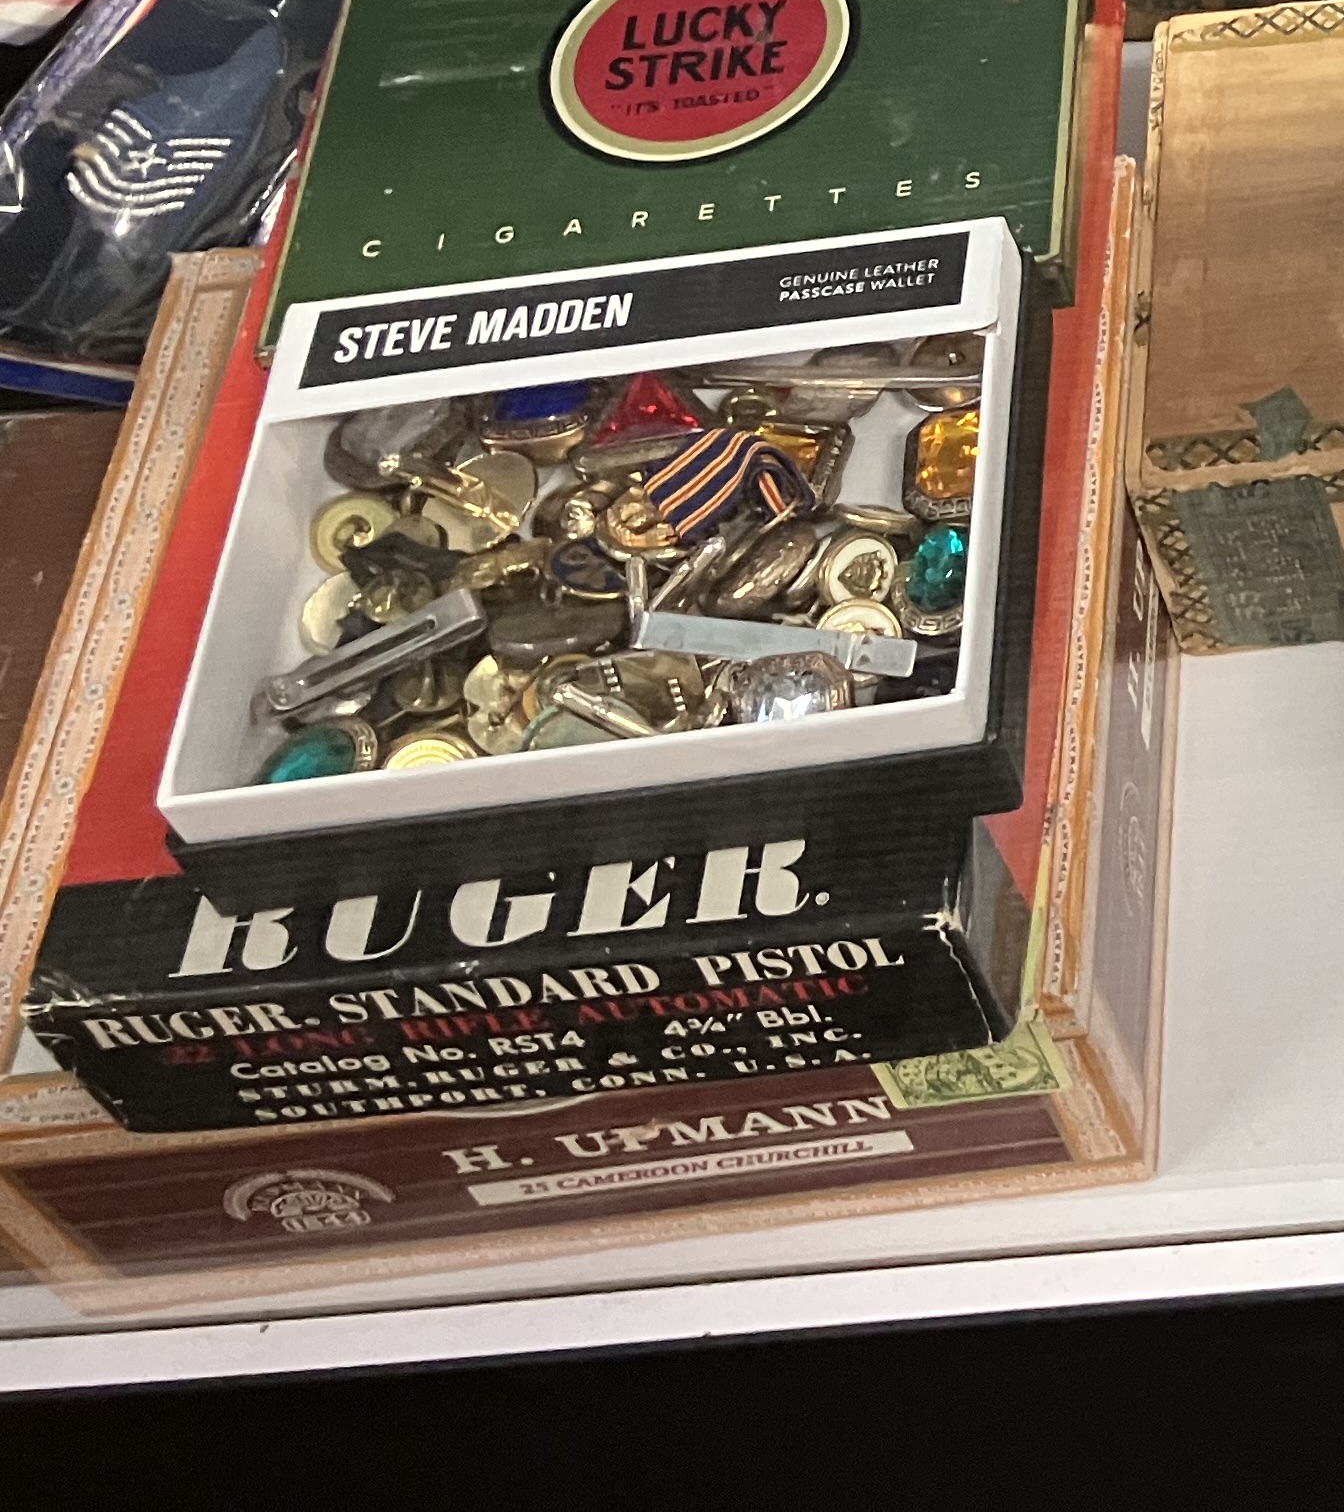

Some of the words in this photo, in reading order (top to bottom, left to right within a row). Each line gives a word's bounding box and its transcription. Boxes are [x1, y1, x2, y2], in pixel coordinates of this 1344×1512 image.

[604, 40, 788, 91] STRIKE
[361, 170, 984, 261] CIGARETTES
[779, 268, 859, 289] GENUINE
[864, 258, 940, 279] LEATHER
[779, 281, 865, 303] PASSCASE
[870, 272, 936, 292] WALLET
[333, 313, 456, 365] STEVE
[466, 292, 634, 347] MADDEN
[82, 1000, 322, 1051] RUGER.
[329, 963, 661, 1025] STANDARD
[692, 937, 905, 987] PISTOL
[400, 1009, 549, 1041] RIFLE
[577, 974, 870, 1025] AUTOMATIC
[229, 1053, 391, 1080] Catalog
[402, 1043, 477, 1065] No.
[487, 1030, 586, 1058] RST4
[756, 1004, 834, 1029] Bbl.
[769, 1027, 863, 1049] INC.
[571, 1065, 707, 1092] CONN.
[443, 1145, 535, 1175] H.
[554, 1095, 894, 1159] UPMANN
[556, 1160, 709, 1191] CAMEROON
[716, 1140, 874, 1170] CHURCHILL
